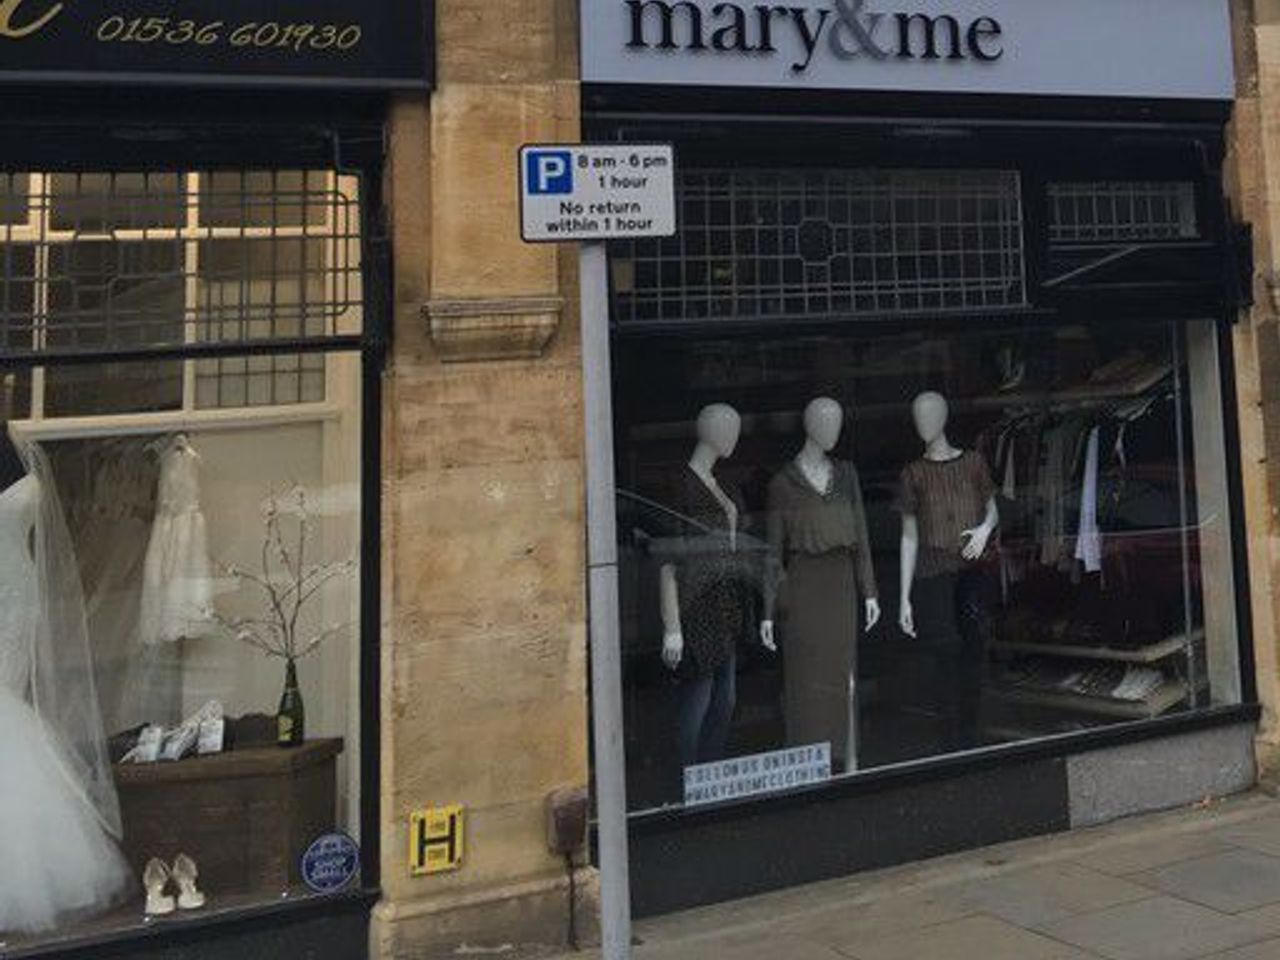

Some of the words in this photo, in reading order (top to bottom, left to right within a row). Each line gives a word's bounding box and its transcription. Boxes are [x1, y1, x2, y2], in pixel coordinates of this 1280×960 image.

[97, 16, 223, 44] 01536
[229, 22, 361, 52] 601930
[577, 155, 588, 168] 8
[592, 157, 616, 168] am
[629, 154, 640, 168] 6
[642, 156, 668, 169] pm
[539, 156, 565, 190] P
[599, 175, 605, 188] 1
[610, 175, 649, 189] hour
[560, 201, 584, 215] No
[589, 201, 641, 215] return
[546, 218, 599, 233] within
[604, 218, 610, 230] 1
[616, 218, 652, 231] hour
